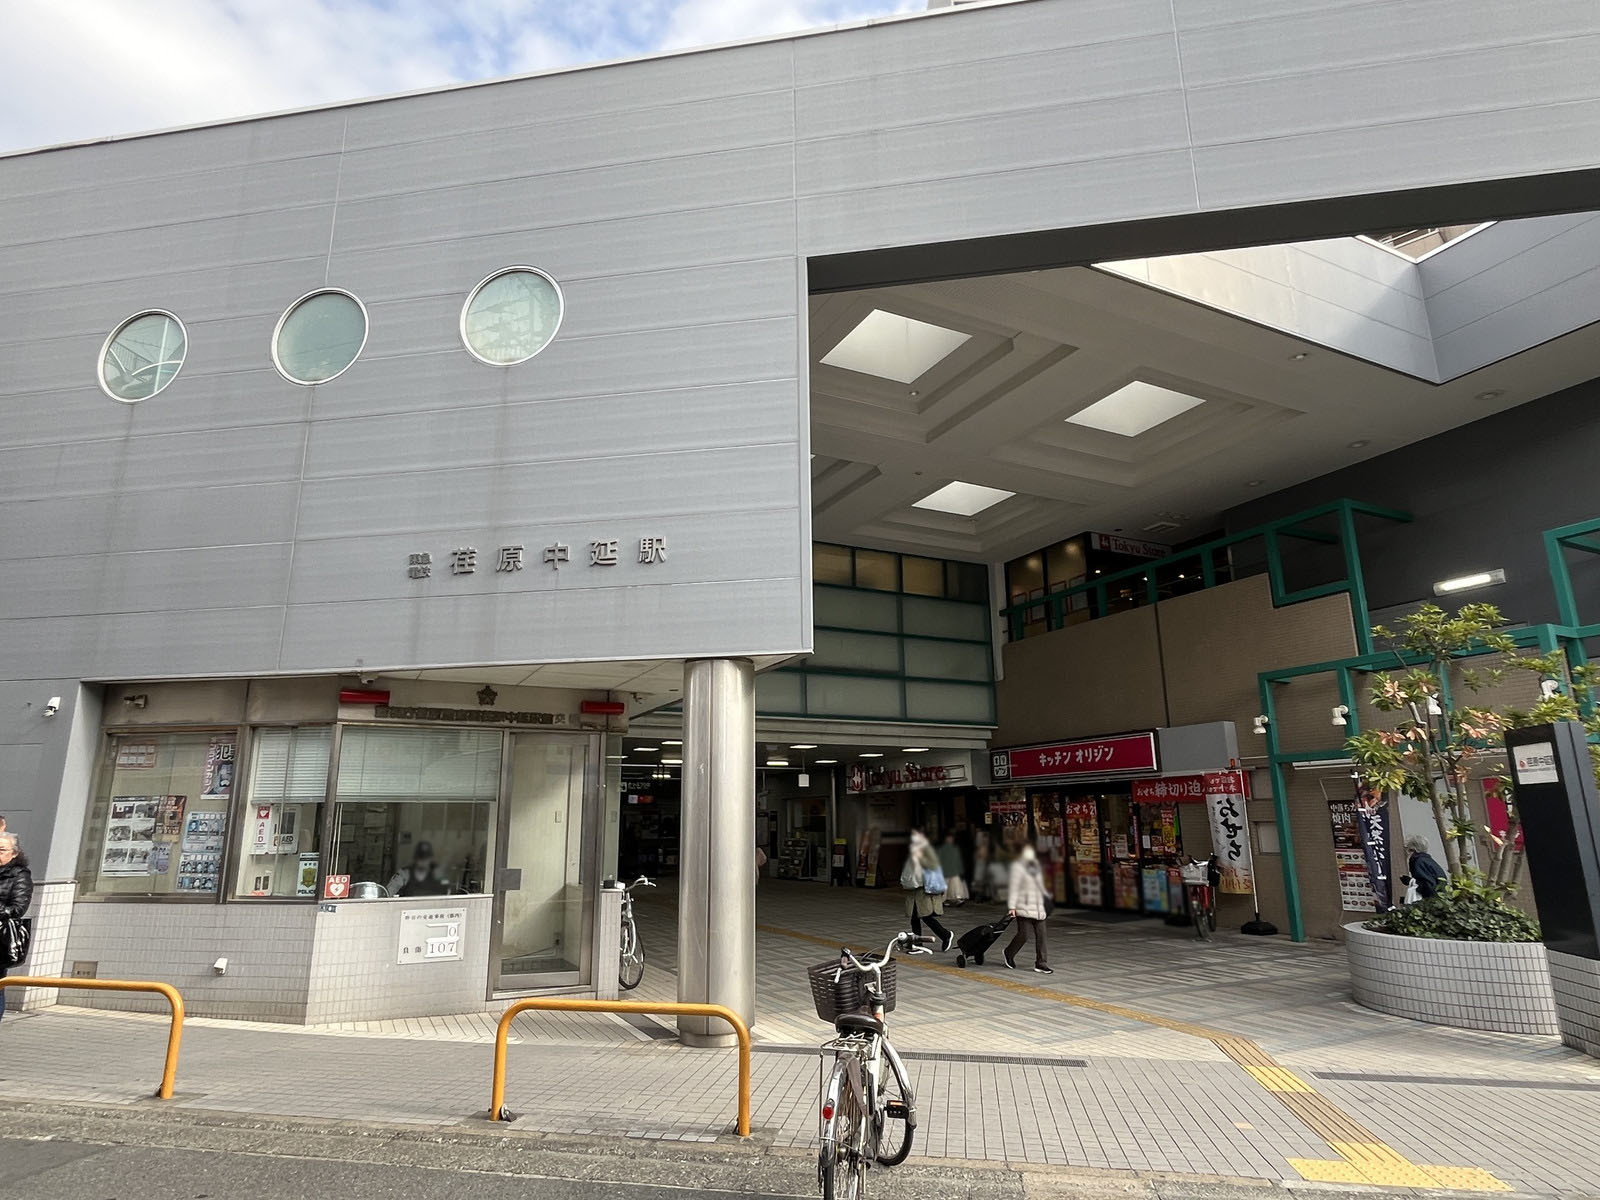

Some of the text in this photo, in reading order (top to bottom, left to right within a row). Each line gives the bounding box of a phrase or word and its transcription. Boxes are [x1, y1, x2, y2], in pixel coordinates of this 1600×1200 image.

[1114, 538, 1141, 554] Tokyu
[450, 535, 667, 575] 荏原中延駅
[1039, 745, 1114, 767] キッチン オリジン
[904, 761, 945, 784] Store
[1137, 780, 1206, 797] おせち締切り迫
[258, 821, 266, 843] AED
[328, 876, 348, 884] AED
[448, 926, 457, 938] 0
[430, 942, 455, 954] 107
